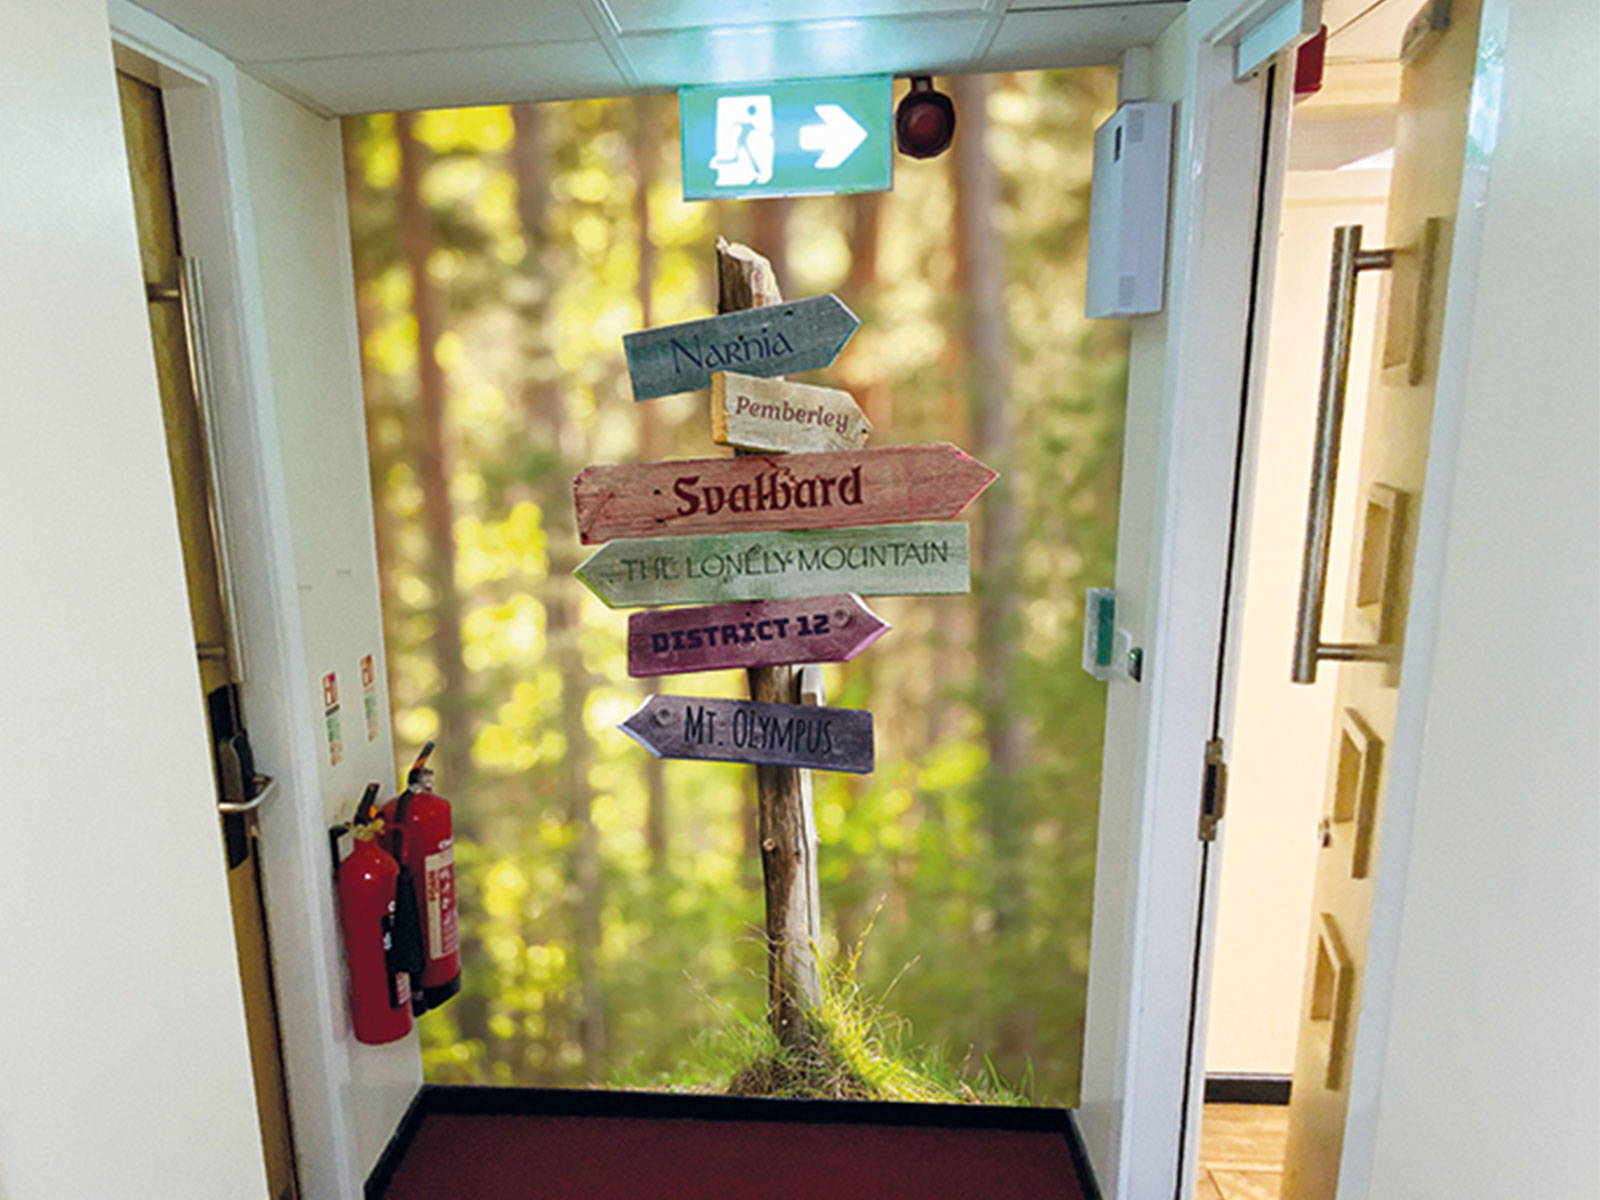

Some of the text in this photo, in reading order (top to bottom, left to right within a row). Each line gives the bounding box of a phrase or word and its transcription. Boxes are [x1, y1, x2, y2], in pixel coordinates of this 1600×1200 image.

[670, 329, 794, 373] Narnia
[736, 396, 849, 433] Pemberley
[673, 466, 863, 517] Svalbard
[621, 540, 949, 582] THE LONELY MOUNTAIN
[652, 614, 831, 653] DISTRICT 12
[733, 708, 833, 754] OLYMPUS
